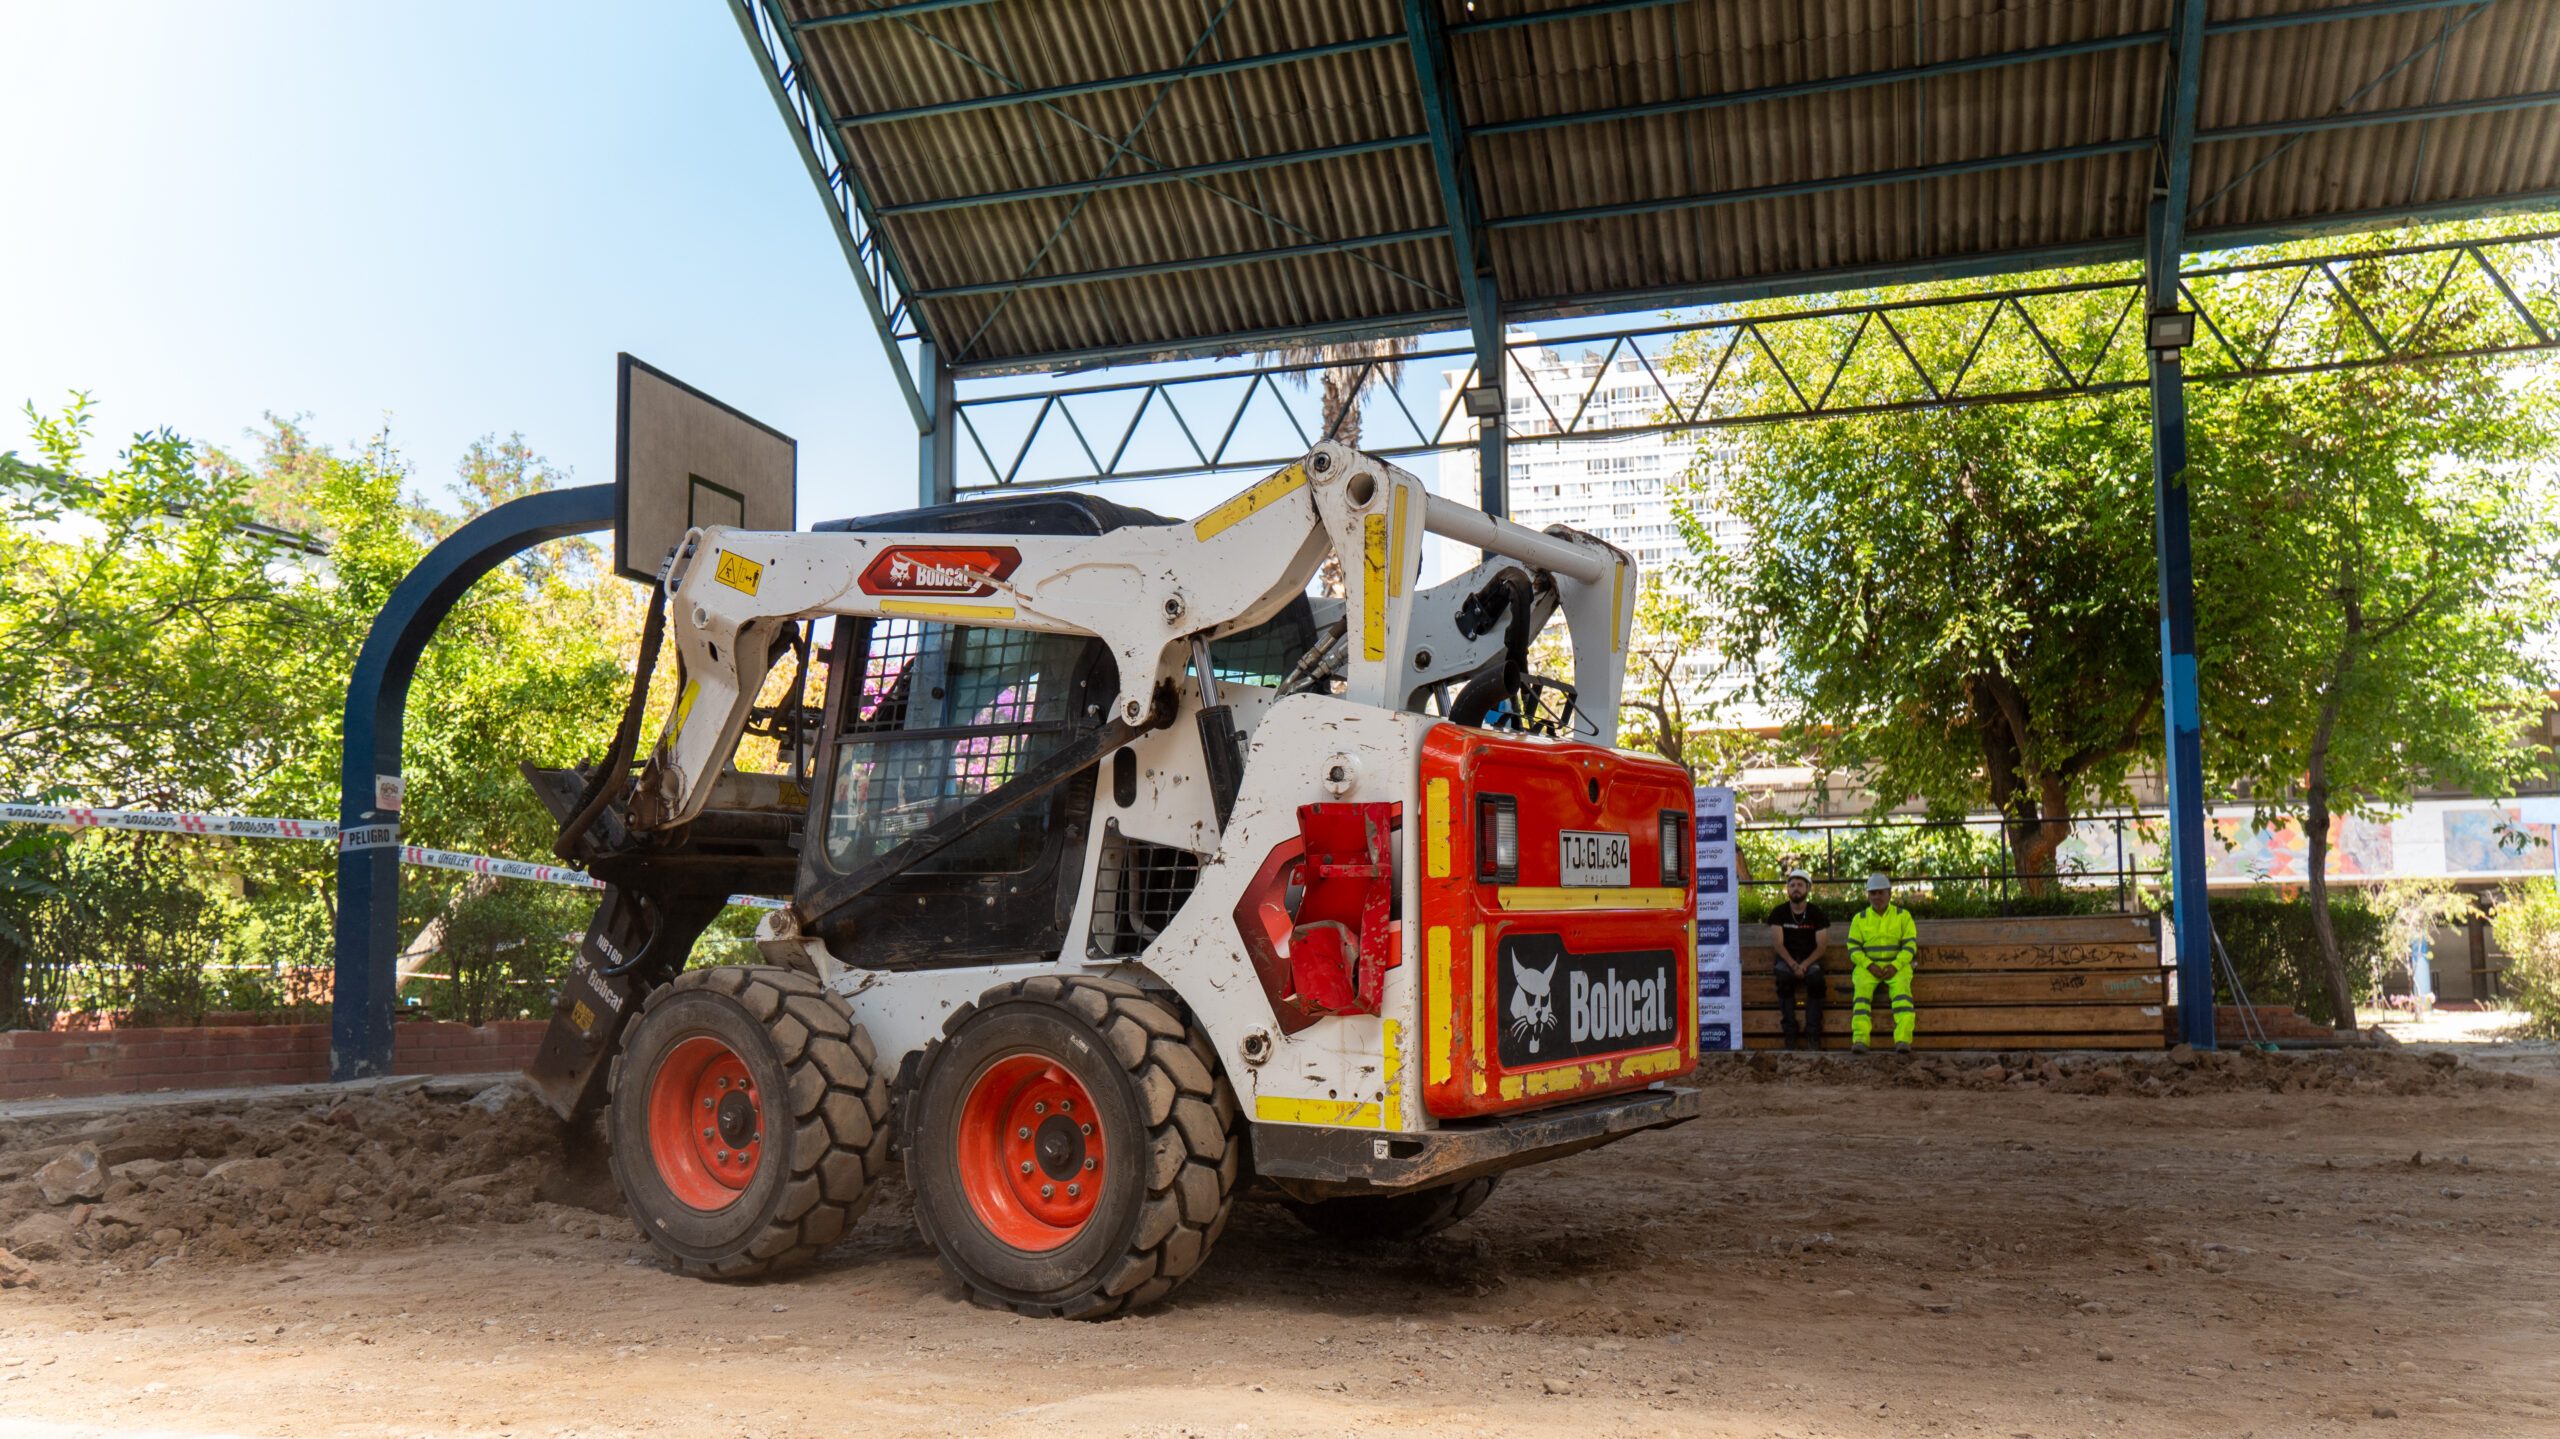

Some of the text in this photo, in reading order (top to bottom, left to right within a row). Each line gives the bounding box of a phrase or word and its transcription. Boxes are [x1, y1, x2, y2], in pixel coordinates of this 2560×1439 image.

[916, 563, 970, 587] Bobcat
[349, 828, 390, 846] PELIGRO
[1585, 874, 1608, 884] CHILE
[596, 933, 623, 965] NB160
[587, 968, 624, 1013] Bobcat
[1569, 966, 1667, 1043] Bobcat
